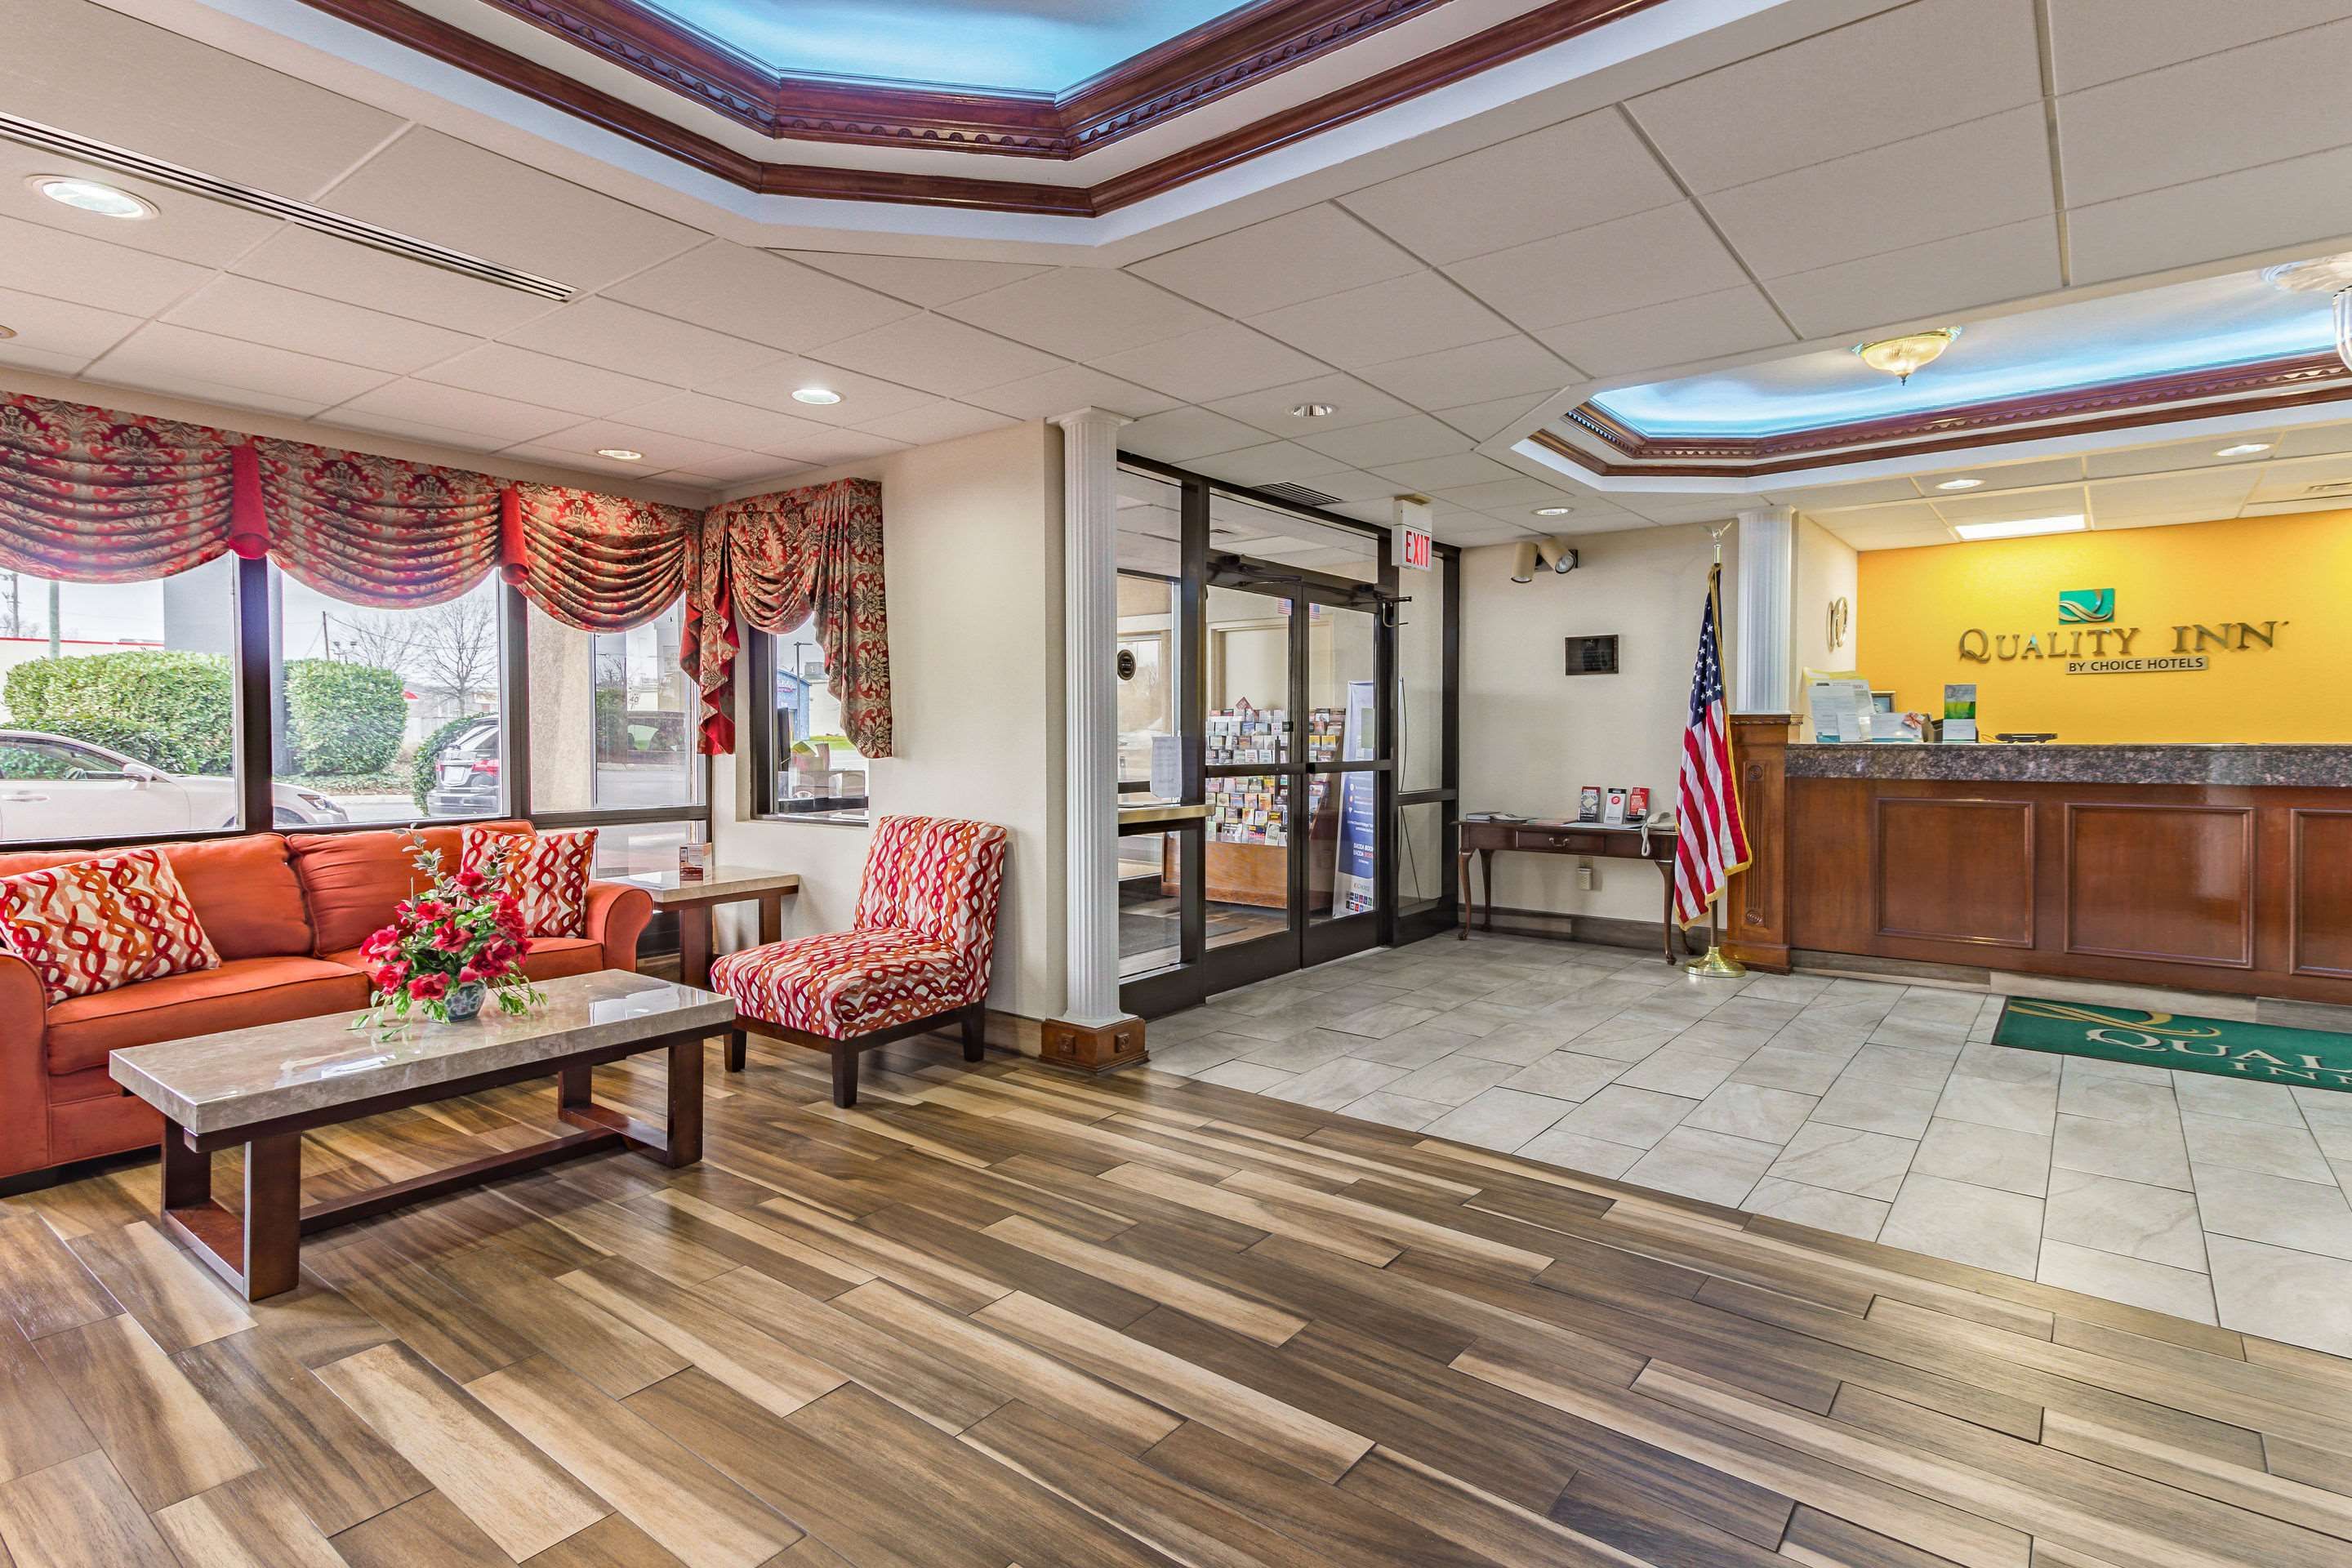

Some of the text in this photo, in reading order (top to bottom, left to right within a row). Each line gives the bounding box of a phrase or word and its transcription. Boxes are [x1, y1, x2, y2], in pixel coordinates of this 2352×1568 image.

[1405, 530, 1430, 568] EXIT
[1958, 621, 2278, 663] QUALITY INN
[2069, 657, 2204, 672] BY CHOICE HOTELS
